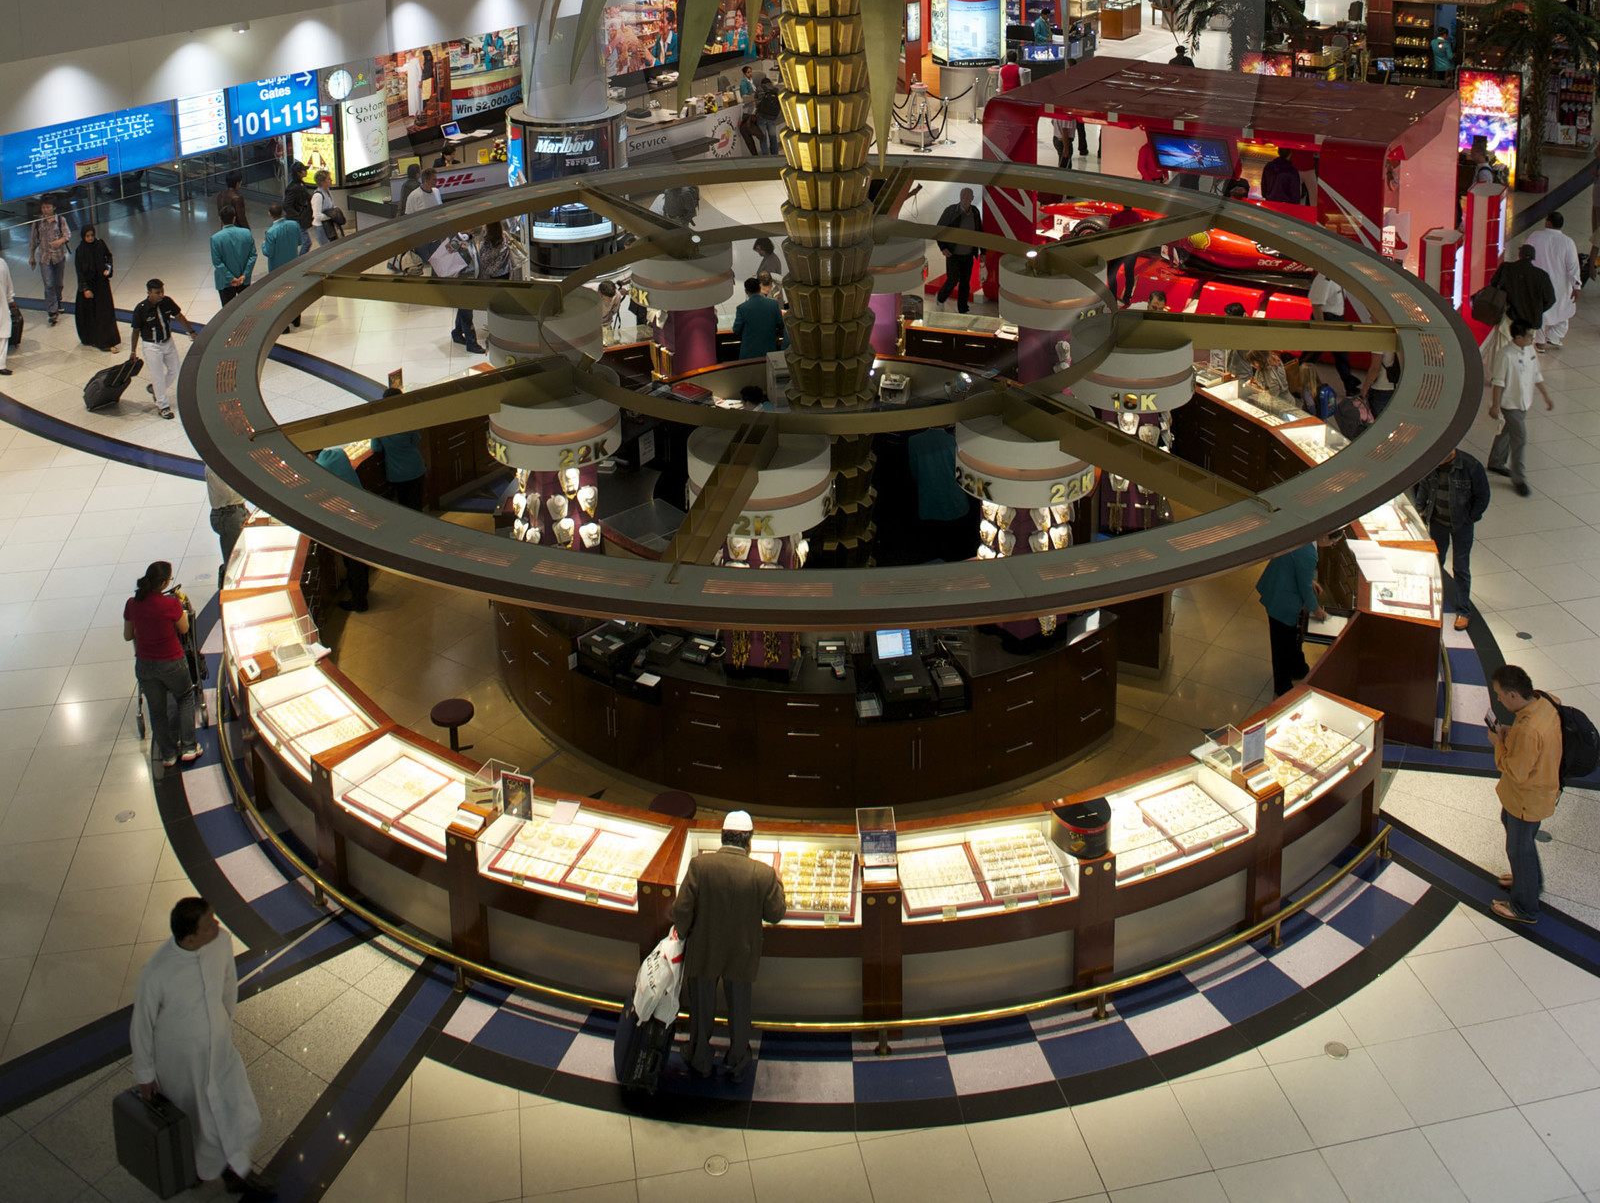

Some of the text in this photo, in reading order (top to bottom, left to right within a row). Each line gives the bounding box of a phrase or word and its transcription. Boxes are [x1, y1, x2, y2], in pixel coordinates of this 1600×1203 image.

[260, 86, 291, 101] Gates
[467, 85, 487, 96] Dubai
[487, 81, 502, 94] Duty
[233, 98, 319, 137] 101-115
[456, 104, 473, 114] Win
[534, 136, 594, 154] Marlboro
[629, 136, 667, 152] Service
[1257, 259, 1282, 267] acer
[1111, 392, 1158, 411] 18K
[559, 438, 609, 468] 22K
[955, 466, 994, 501] 22K
[1050, 472, 1093, 504] 22K
